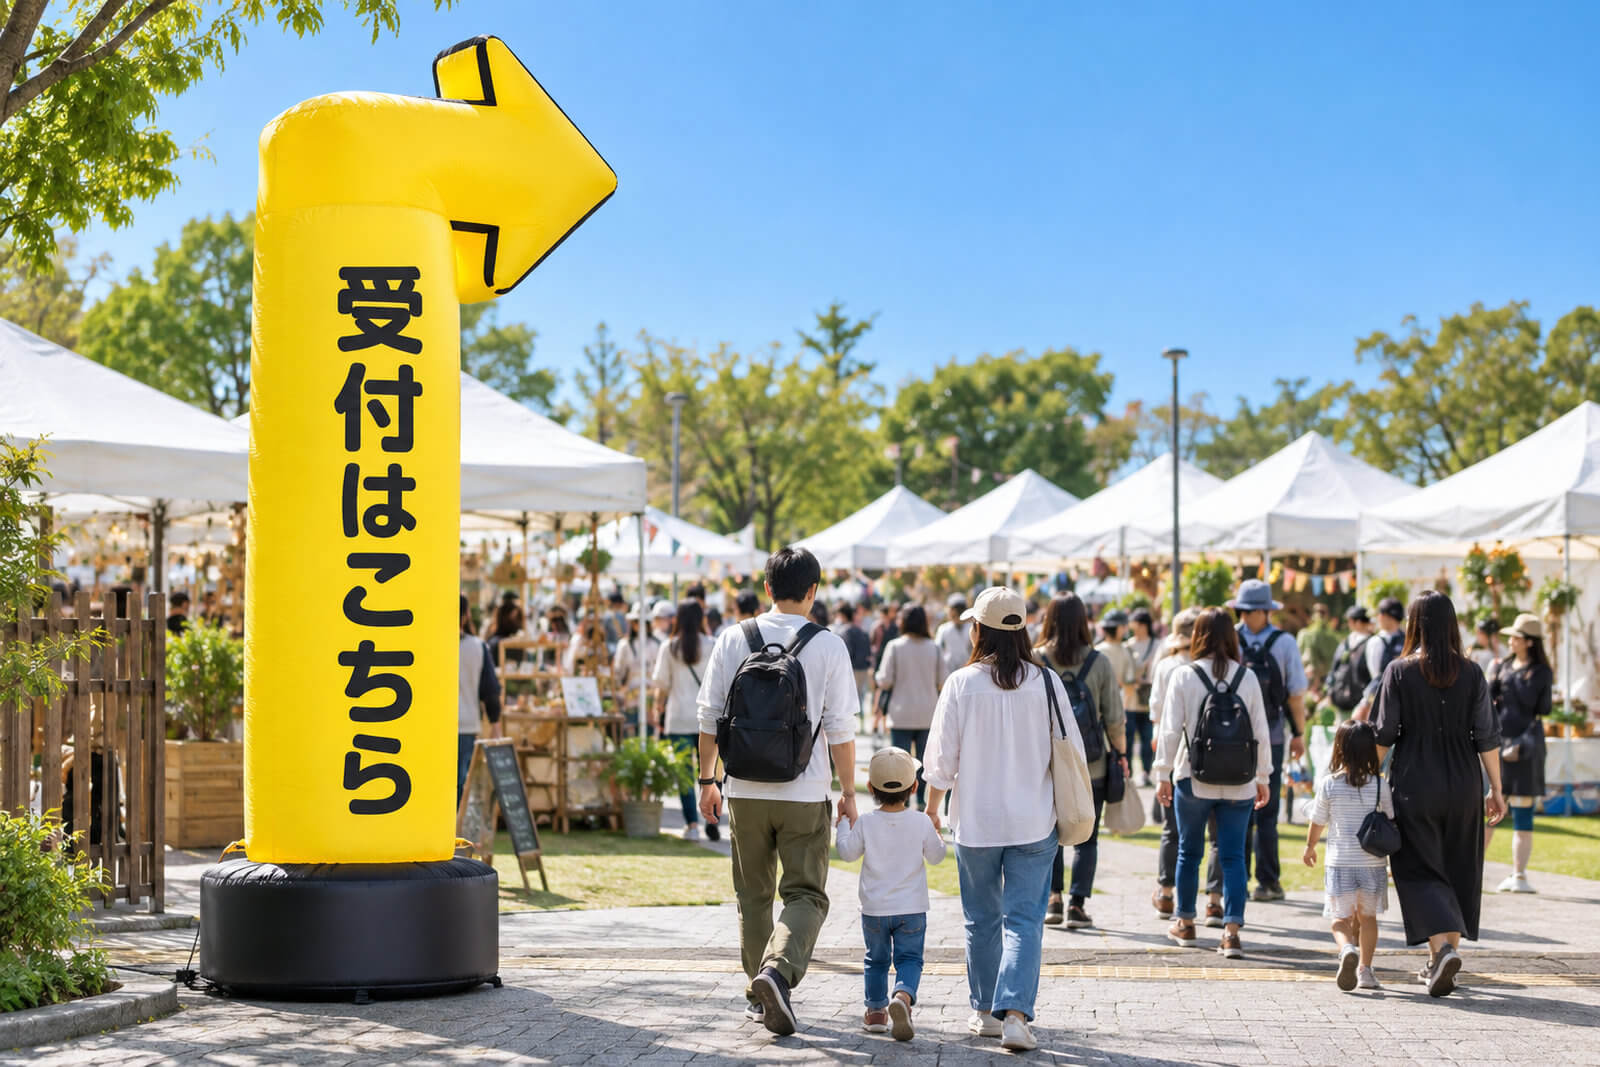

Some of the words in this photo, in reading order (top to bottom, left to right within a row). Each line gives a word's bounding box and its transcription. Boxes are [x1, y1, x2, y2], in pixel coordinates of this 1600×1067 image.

[334, 266, 423, 815] 受付はこちら
